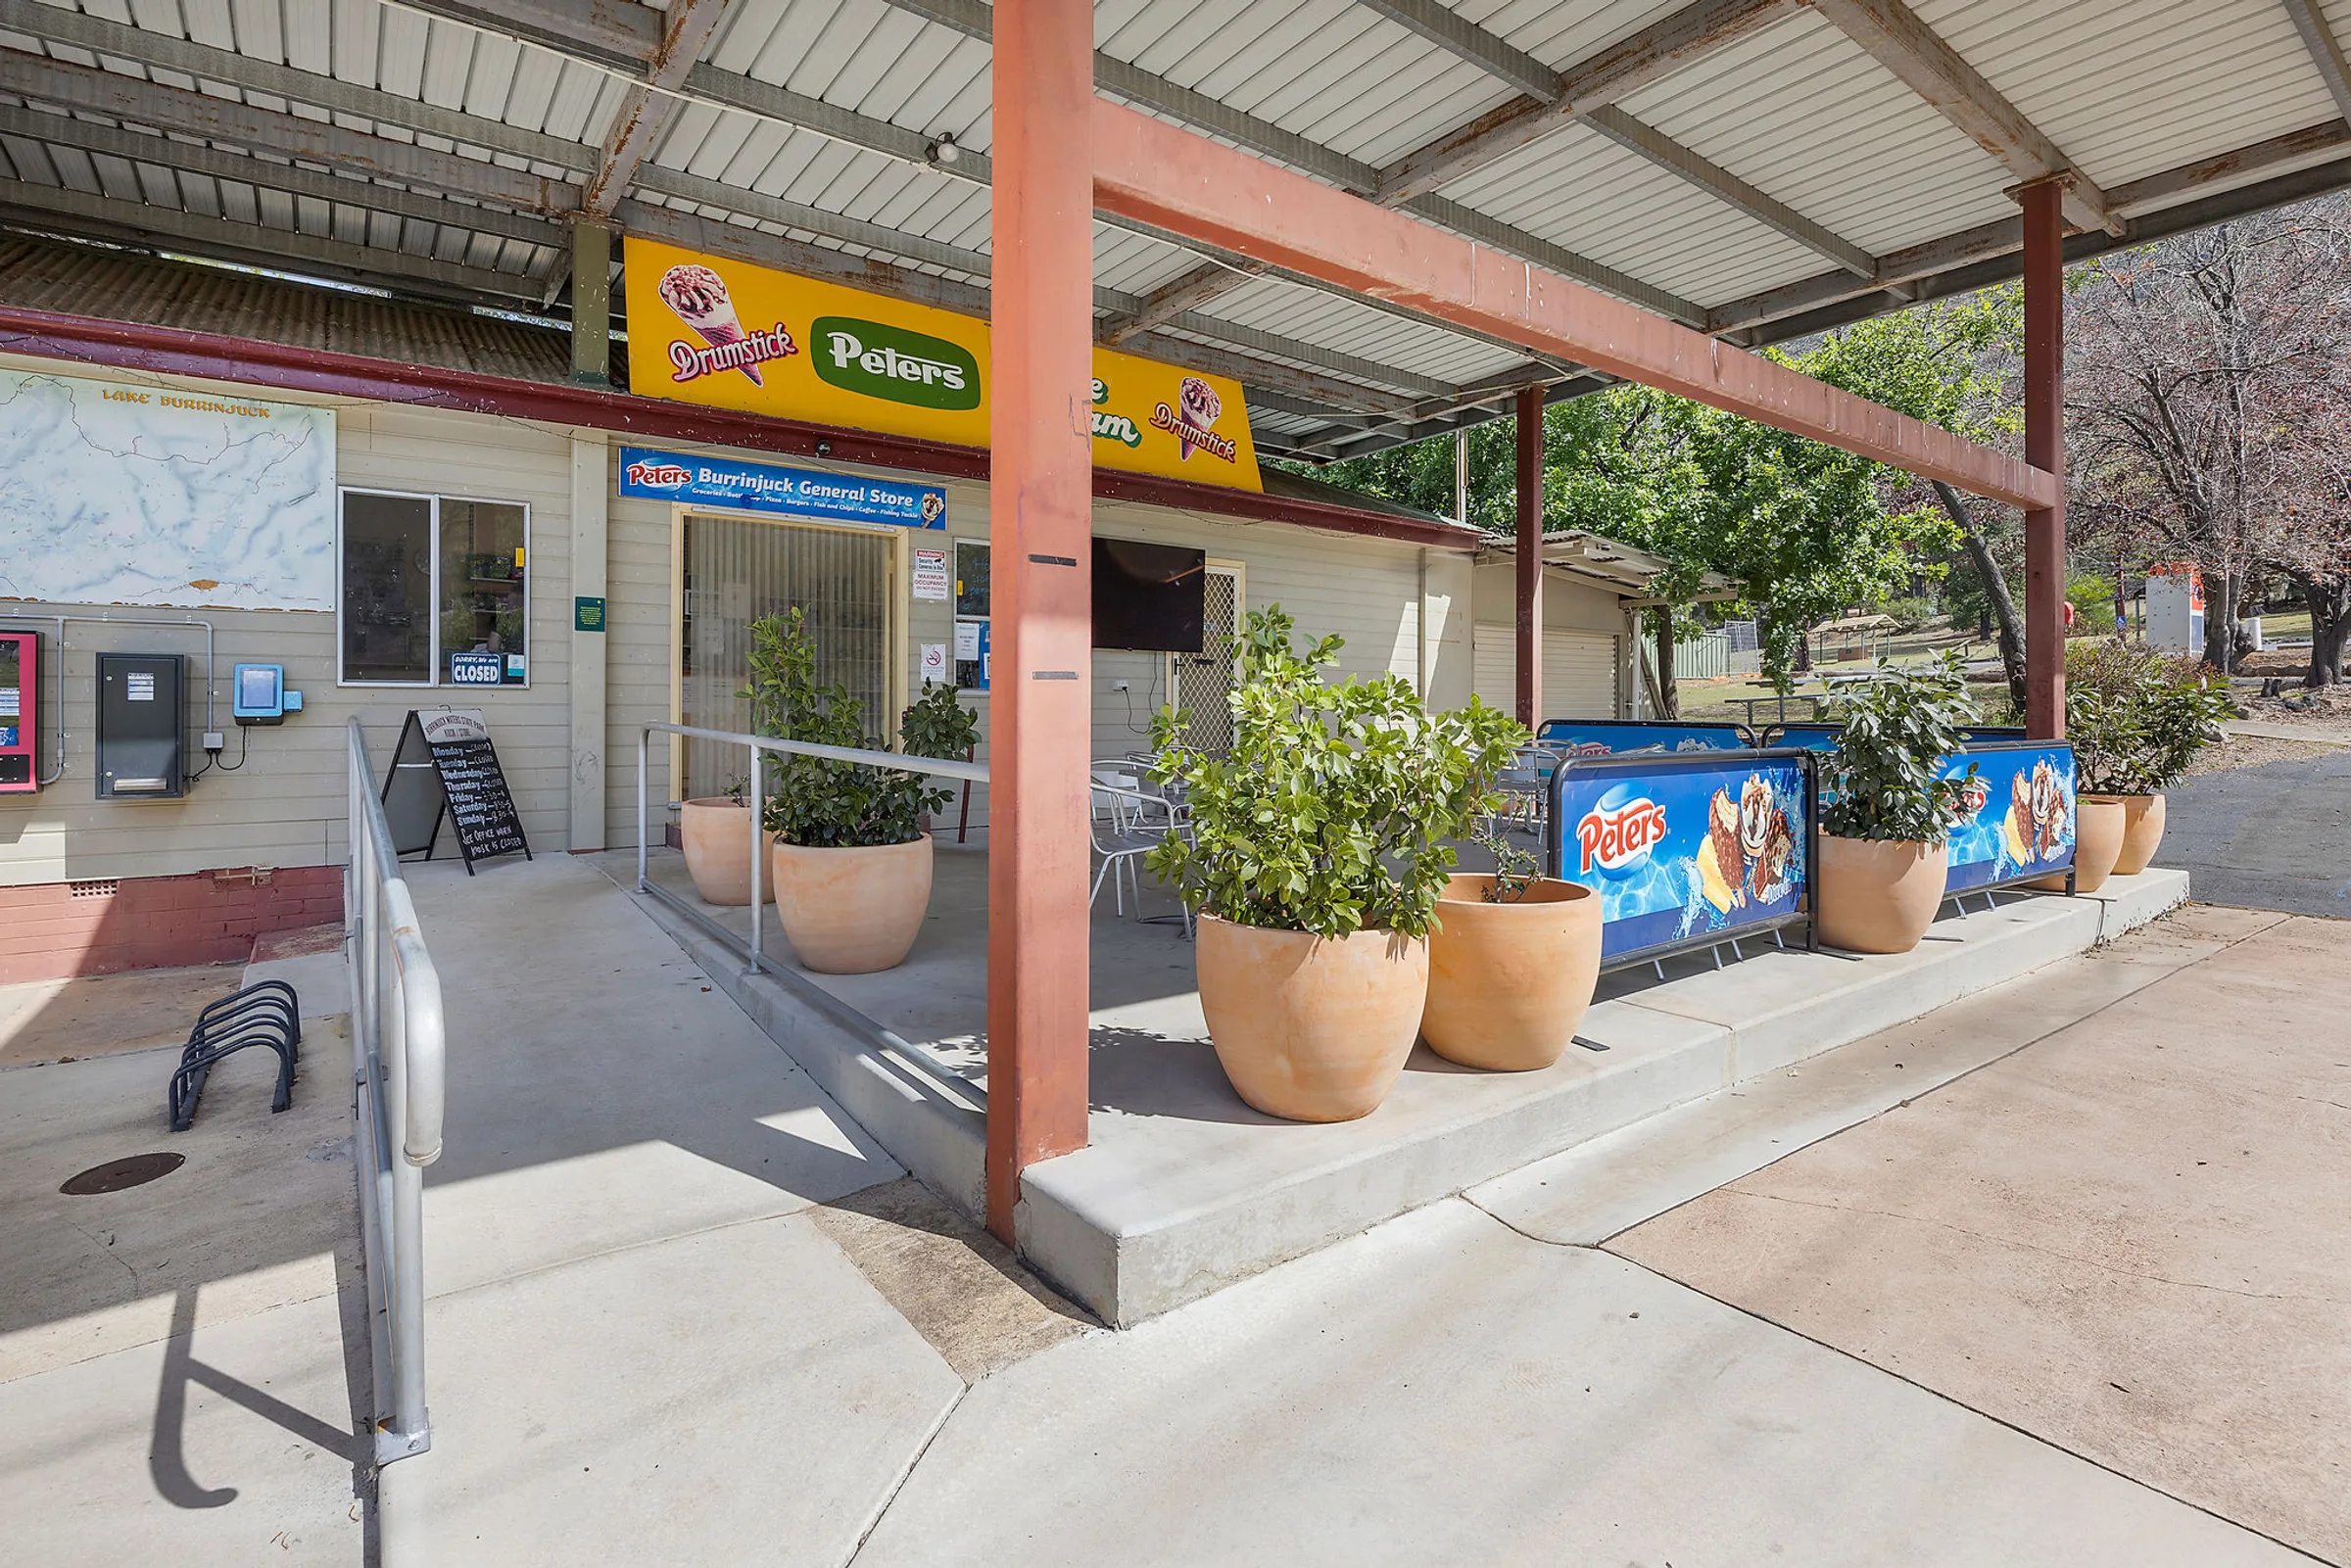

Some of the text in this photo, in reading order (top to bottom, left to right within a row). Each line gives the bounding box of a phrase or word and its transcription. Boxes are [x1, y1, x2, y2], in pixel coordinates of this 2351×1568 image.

[668, 322, 797, 382] Drumstick
[827, 332, 966, 390] Peters
[103, 389, 270, 418] LAKE BURRINJUCK
[1150, 403, 1235, 462] Drumstick
[627, 464, 692, 485] Peters
[698, 467, 913, 507] Burrinjuck General Store
[692, 488, 722, 497] Groceries
[880, 508, 900, 517] Fishing
[455, 665, 498, 682] CLOSED
[432, 746, 463, 757] Monday
[437, 759, 467, 768] Tuesday
[441, 769, 483, 780] Wednesday
[445, 780, 480, 791] Thursday
[449, 792, 473, 803] Friday
[454, 802, 487, 815] Saturday
[456, 813, 486, 827] Sunday
[473, 829, 495, 841] OFFICE
[500, 836, 522, 849] CLOSED
[1577, 803, 1665, 872] Peters
